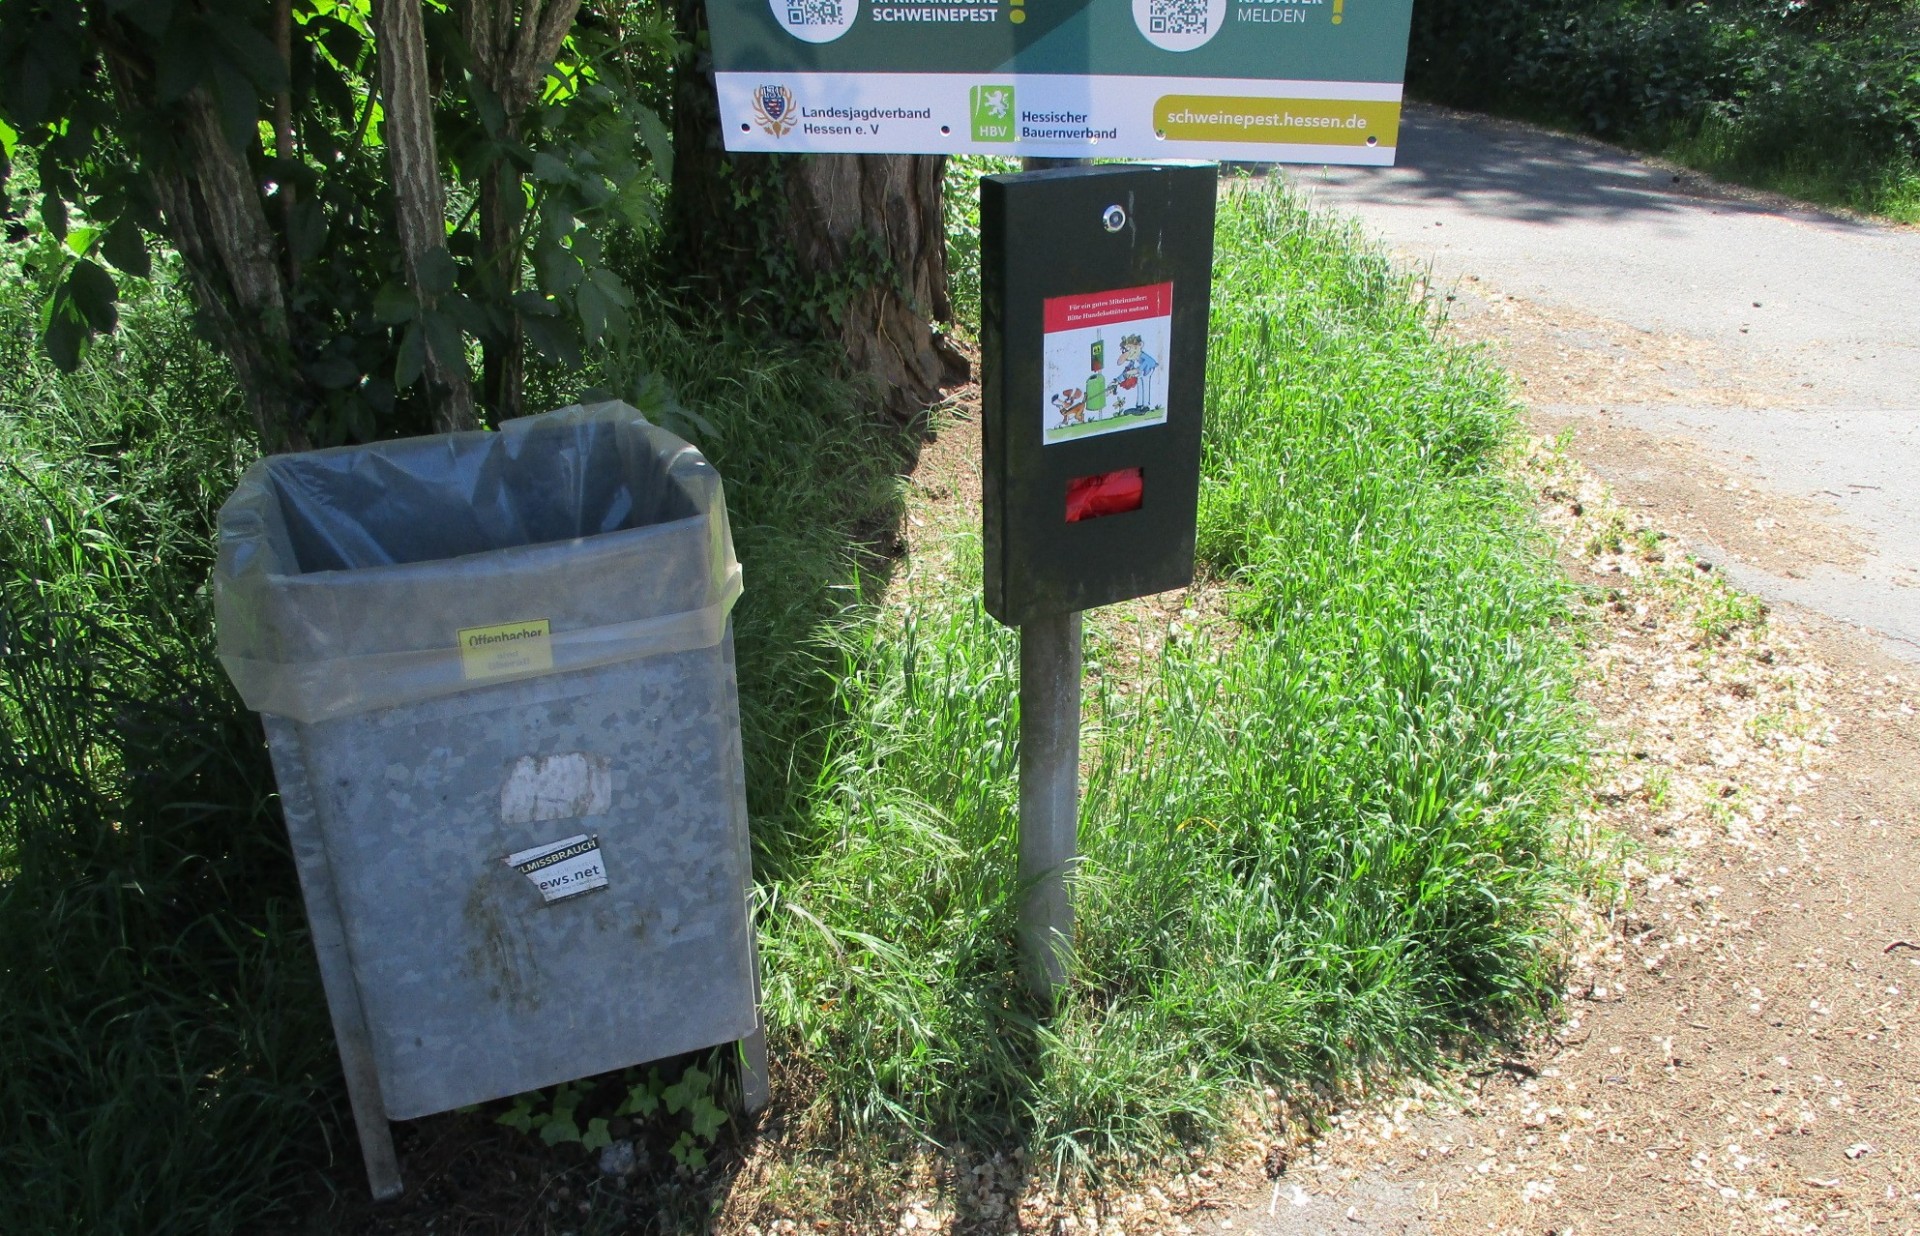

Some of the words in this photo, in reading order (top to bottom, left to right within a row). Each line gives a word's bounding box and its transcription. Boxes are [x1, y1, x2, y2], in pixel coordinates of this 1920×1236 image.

[872, 8, 998, 22] SCHWEINEPEST
[1237, 8, 1306, 23] MELDEN
[801, 106, 931, 120] Landesjagdverband
[1022, 111, 1088, 123] Hessischer
[1167, 109, 1367, 130] schweinepest.hessen.de
[803, 123, 852, 135] Hessen
[855, 125, 867, 135] e.
[870, 124, 879, 135] V
[979, 126, 1007, 137] HBV
[1022, 126, 1117, 139] Bauernverband
[518, 839, 597, 874] LMISSBRAUCH
[539, 864, 600, 891] ews.net
